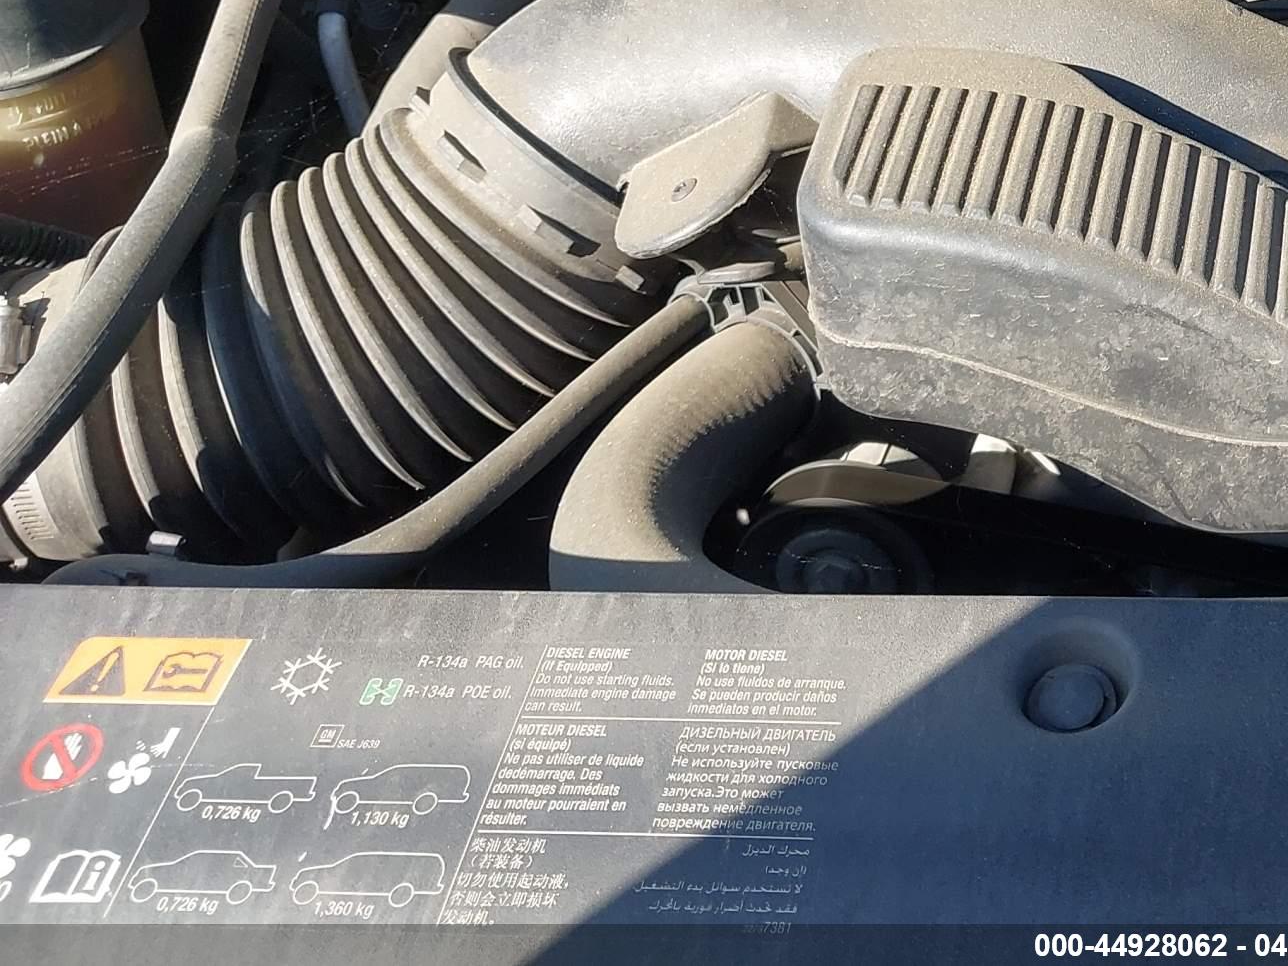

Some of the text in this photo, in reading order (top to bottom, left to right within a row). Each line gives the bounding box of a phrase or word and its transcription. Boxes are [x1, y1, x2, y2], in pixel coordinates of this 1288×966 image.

[547, 647, 631, 659] DIESEL ENGINE
[705, 649, 788, 662] MOTOR DIESEL
[417, 655, 525, 669] R-134a PAG oil.
[541, 660, 613, 674] (If Equipped)
[700, 663, 765, 676] (Si lo tiene)
[536, 673, 675, 688] Do not use starting fluids.
[696, 676, 847, 691] No use fluidos de arranque.
[403, 685, 513, 699] R-134a POE oil.
[530, 687, 676, 701] Immediate engine damage
[691, 689, 837, 703] Se pueden producir daños
[524, 701, 583, 712] can result.
[688, 703, 817, 716] inmediatos en el motor.
[515, 724, 607, 737] MOTEUR DIESEL
[679, 726, 836, 742] ДИЗЕЛЬНЫЙ ДВИГАТЕЛЬ
[338, 739, 381, 749] SAE J639
[509, 738, 571, 752] (si équipé)
[675, 741, 791, 757] (если установлен)
[504, 753, 644, 768] Ne pas utiliser de liquide
[671, 756, 839, 772] Не используйте пусковые
[580, 768, 603, 780] Des
[666, 772, 828, 786] жидкости для холодного
[492, 783, 621, 797] dommages immédiats
[741, 790, 784, 799] может
[486, 799, 626, 812] au moteur pourraient en
[657, 803, 803, 816] вызвать немедленное
[202, 806, 261, 823] 0,726 kg
[351, 811, 410, 828] 1,130 kg
[480, 813, 528, 825] résulter.
[652, 818, 816, 832] повреждение двигателя.
[470, 837, 546, 853] 柴油发动机
[157, 897, 218, 914] 0,726 kg
[450, 891, 560, 908] 否则会立即损坏
[314, 901, 374, 919] 1,360 kg
